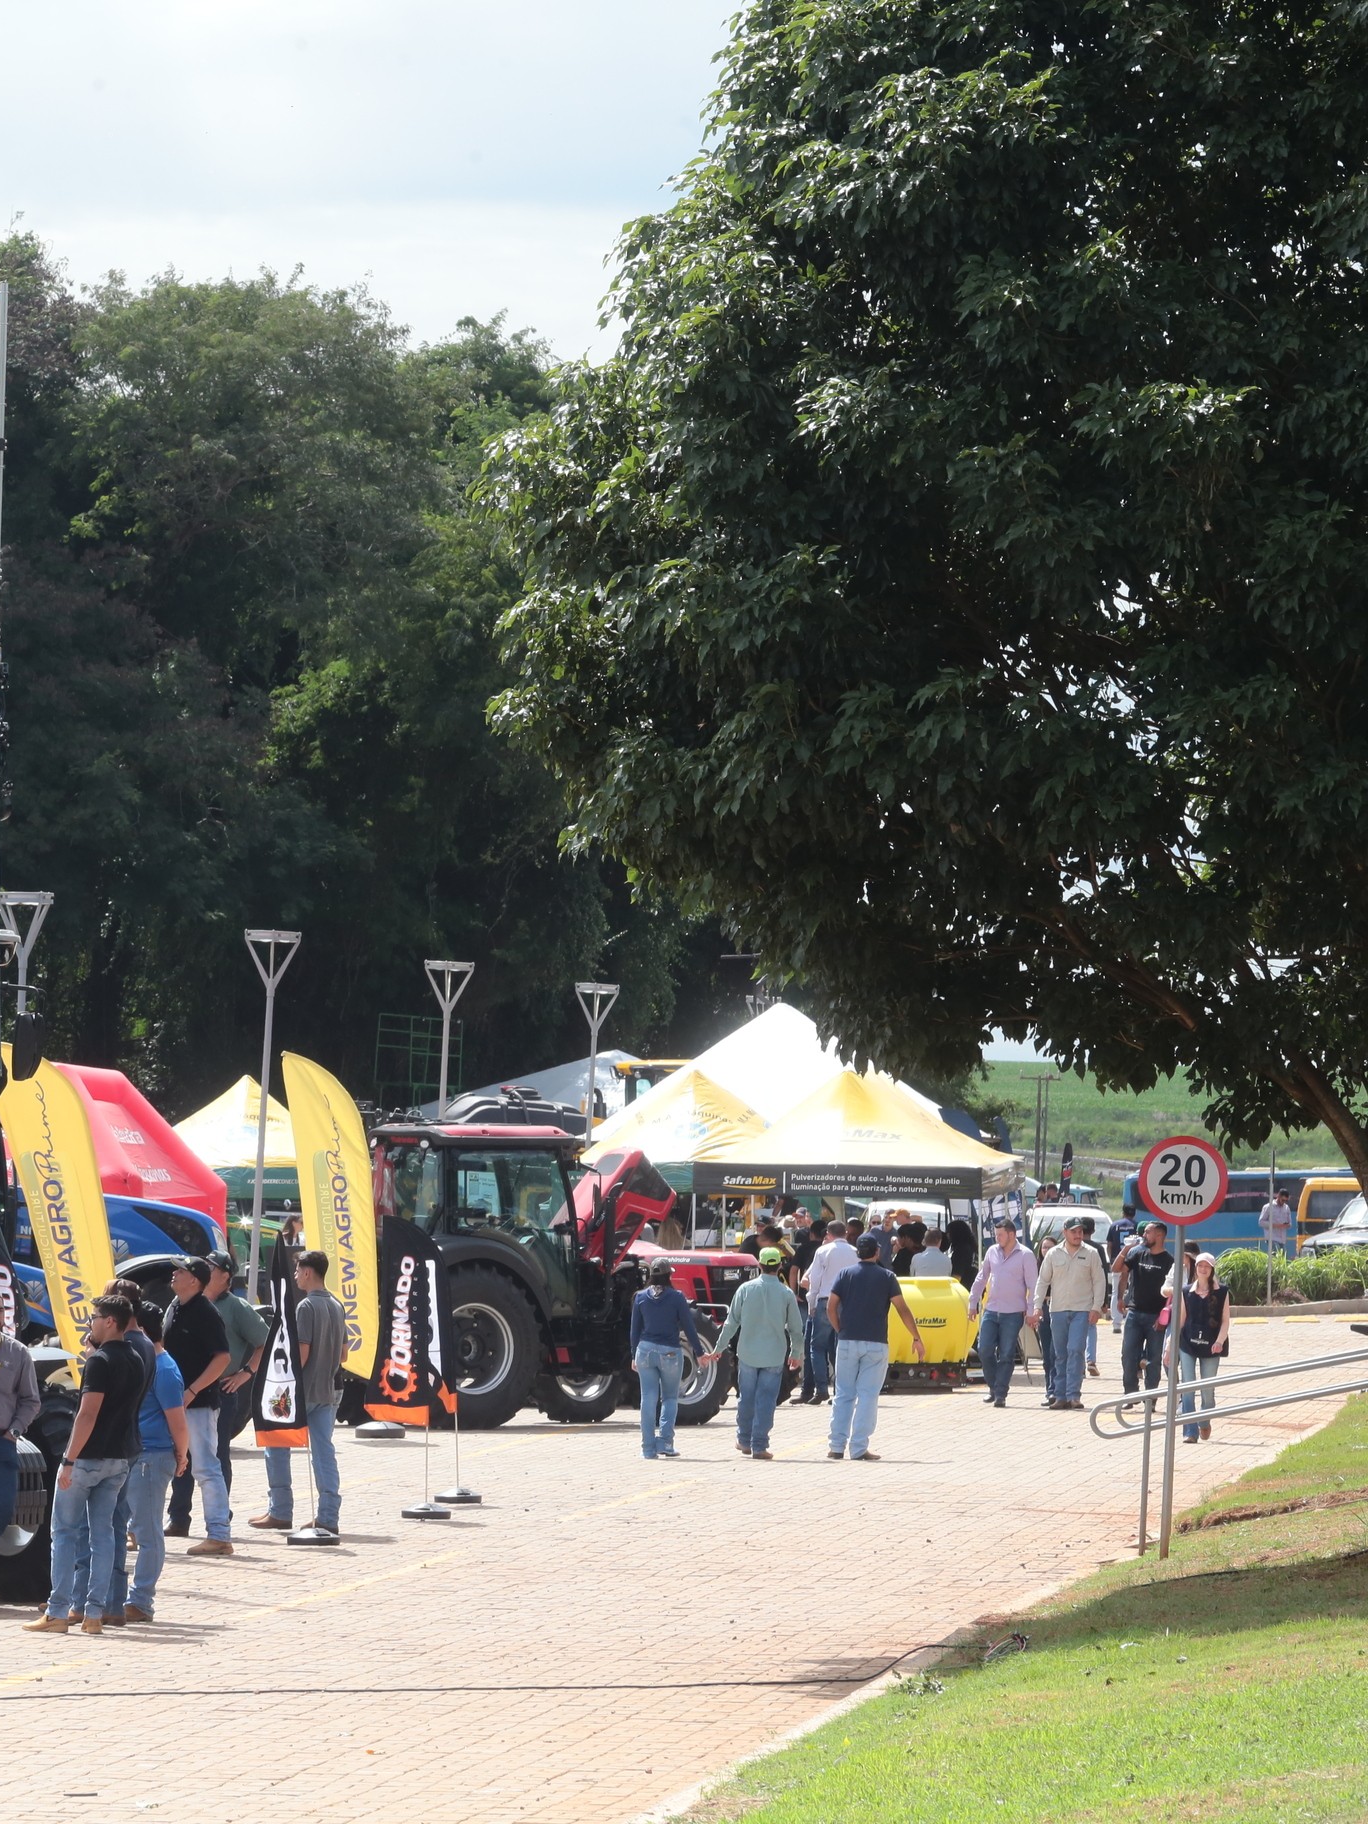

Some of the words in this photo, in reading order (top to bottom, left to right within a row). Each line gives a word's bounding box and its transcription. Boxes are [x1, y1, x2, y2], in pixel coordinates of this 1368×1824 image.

[722, 1175, 777, 1185] SafraMax
[791, 1173, 846, 1182] Pulverizadores
[847, 1174, 857, 1182] de
[858, 1174, 878, 1183] sulco
[886, 1175, 923, 1184] Monitores
[934, 1177, 961, 1186] plantio
[1158, 1153, 1206, 1188] 20
[791, 1182, 831, 1192] Iluminação
[850, 1184, 897, 1194] pulverização
[898, 1186, 928, 1194] noturna
[1160, 1189, 1203, 1206] km/h
[43, 1179, 78, 1267] AGRO
[332, 1175, 352, 1250] AGRO
[340, 1258, 358, 1320] NEW
[389, 1256, 415, 1379] TORNADO
[915, 1316, 947, 1324] SafraMax
